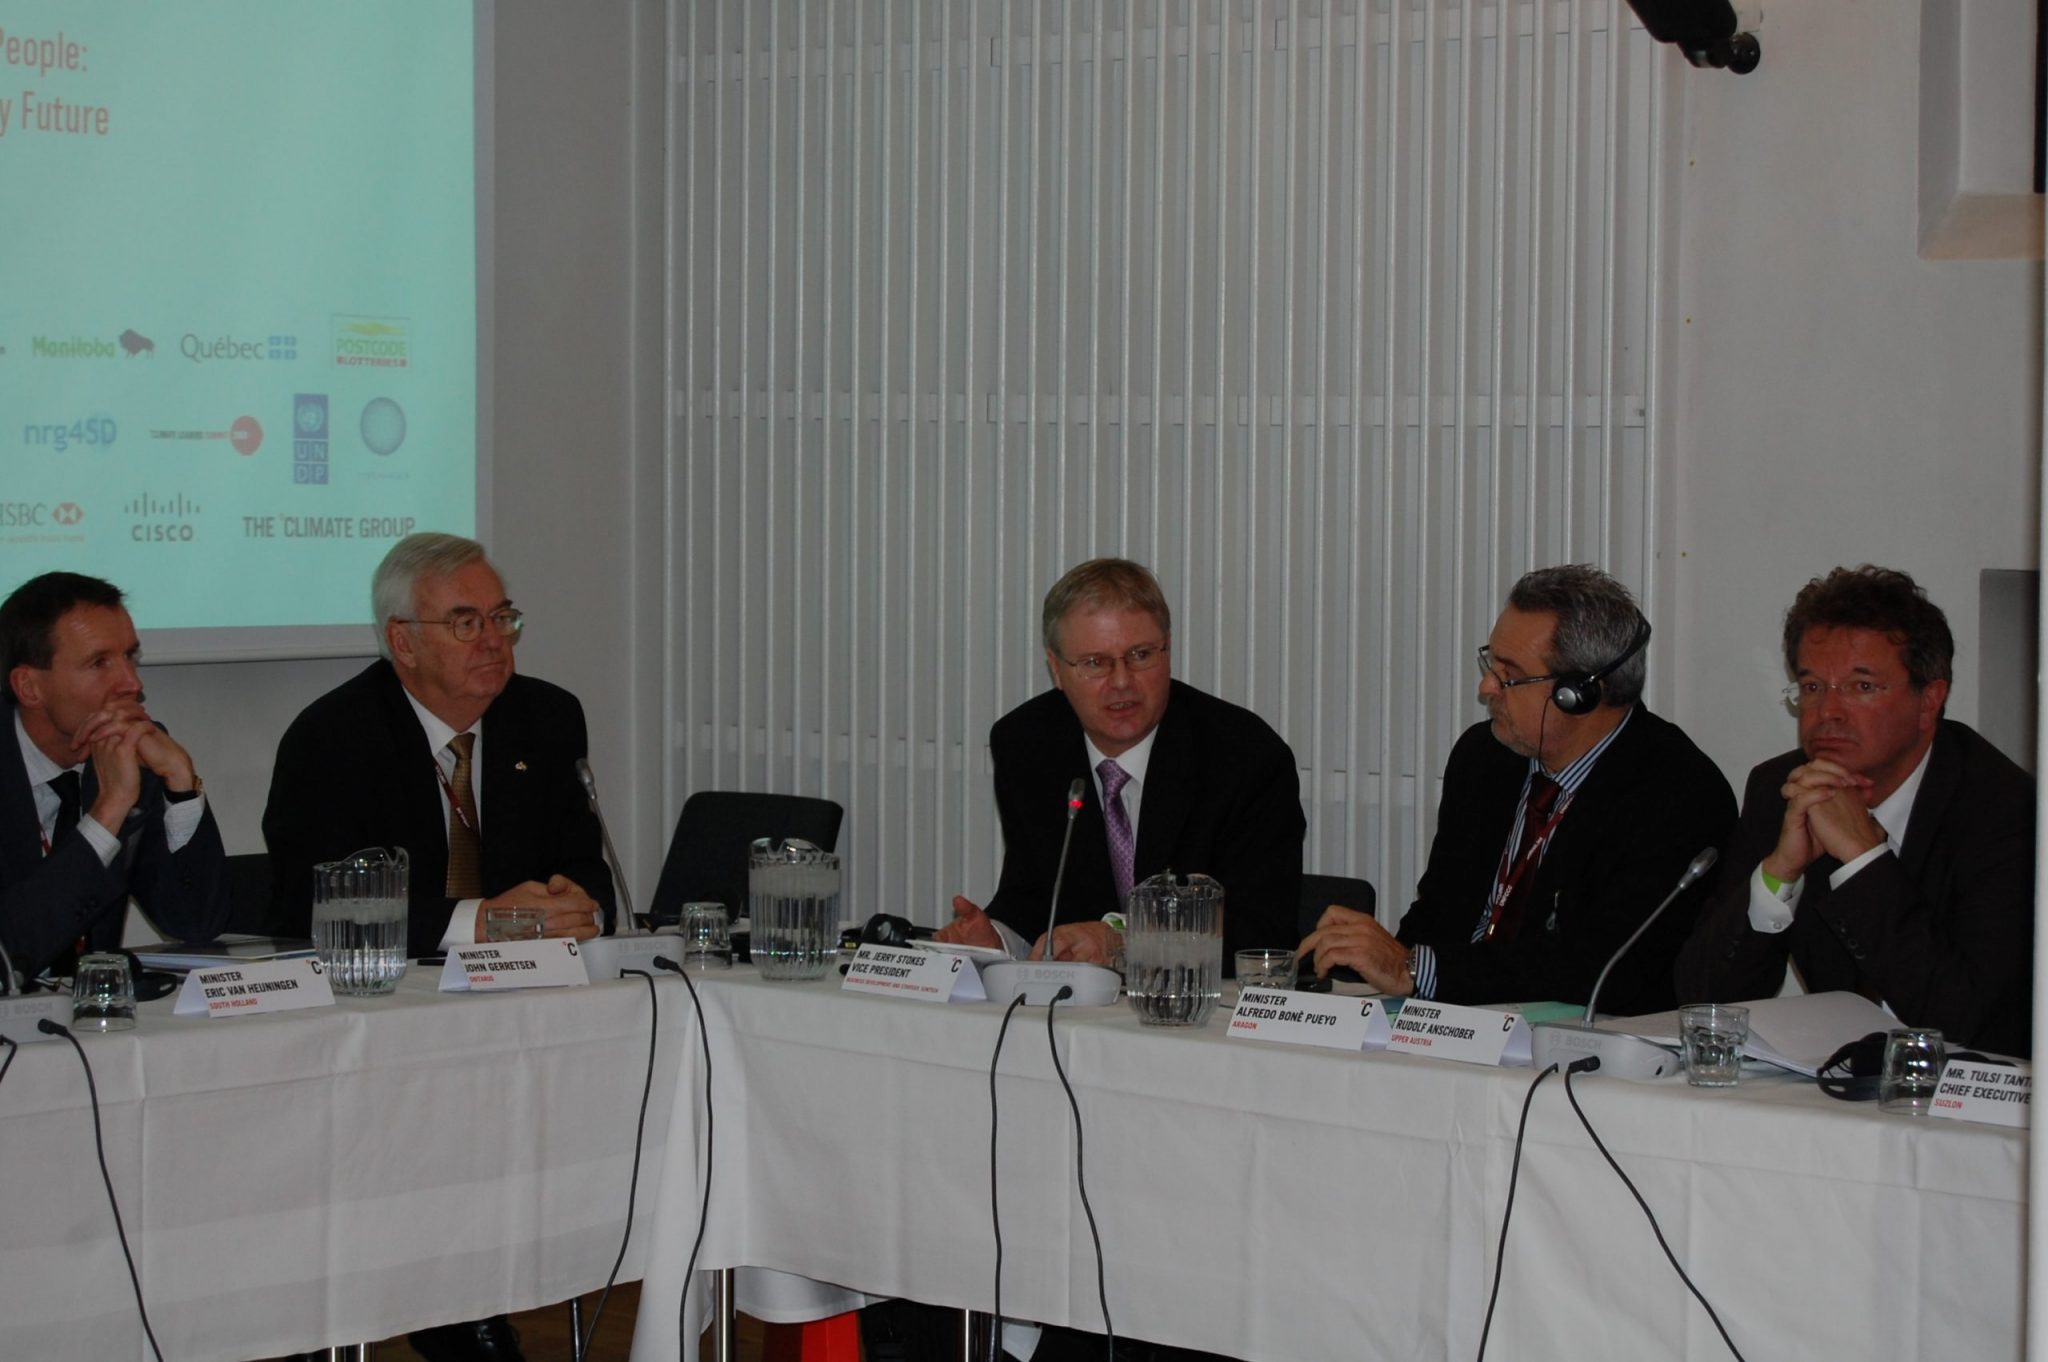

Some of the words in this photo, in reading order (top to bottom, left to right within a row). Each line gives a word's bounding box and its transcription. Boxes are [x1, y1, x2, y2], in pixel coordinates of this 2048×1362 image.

[21, 90, 110, 136] Future
[32, 336, 116, 359] Manitoba
[180, 333, 265, 364] Québec
[336, 338, 408, 356] POSTCODE
[24, 418, 118, 452] nrg4SD
[131, 524, 194, 543] CISCO
[242, 515, 276, 538] THE
[359, 516, 416, 539] GROUP
[458, 949, 501, 961] MINISTER
[856, 950, 872, 961] MR.
[873, 952, 896, 963] JERRY
[897, 954, 927, 967] STOKES
[464, 962, 488, 973] JOHN
[488, 960, 537, 972] GERRETSEN
[851, 962, 869, 973] VICE
[869, 965, 911, 979] PRESIDENT
[1034, 968, 1075, 980] BOSCH
[199, 971, 243, 986] MINISTER
[205, 986, 225, 999] ERIC
[226, 984, 246, 997] VAN
[247, 979, 299, 996] HEUNINGEN
[1241, 992, 1288, 1007] MINISTER
[1236, 1006, 1277, 1021] ALFREDO
[1304, 1013, 1337, 1027] PUEYO
[1401, 1004, 1442, 1020] MINISTER
[1232, 1020, 1258, 1030] ARAGON
[1396, 1019, 1426, 1034] RUDOLF
[1427, 1024, 1475, 1041] ANSCHOBER
[1390, 1034, 1410, 1045] UPPER
[1410, 1036, 1432, 1047] AUSTRIA
[1945, 1067, 1966, 1080] MR.
[1969, 1070, 2001, 1085] TULSI
[1939, 1082, 1972, 1098] CHIEF
[1972, 1086, 2032, 1105] EXECUTIVE
[1933, 1098, 1965, 1110] SUZLON
